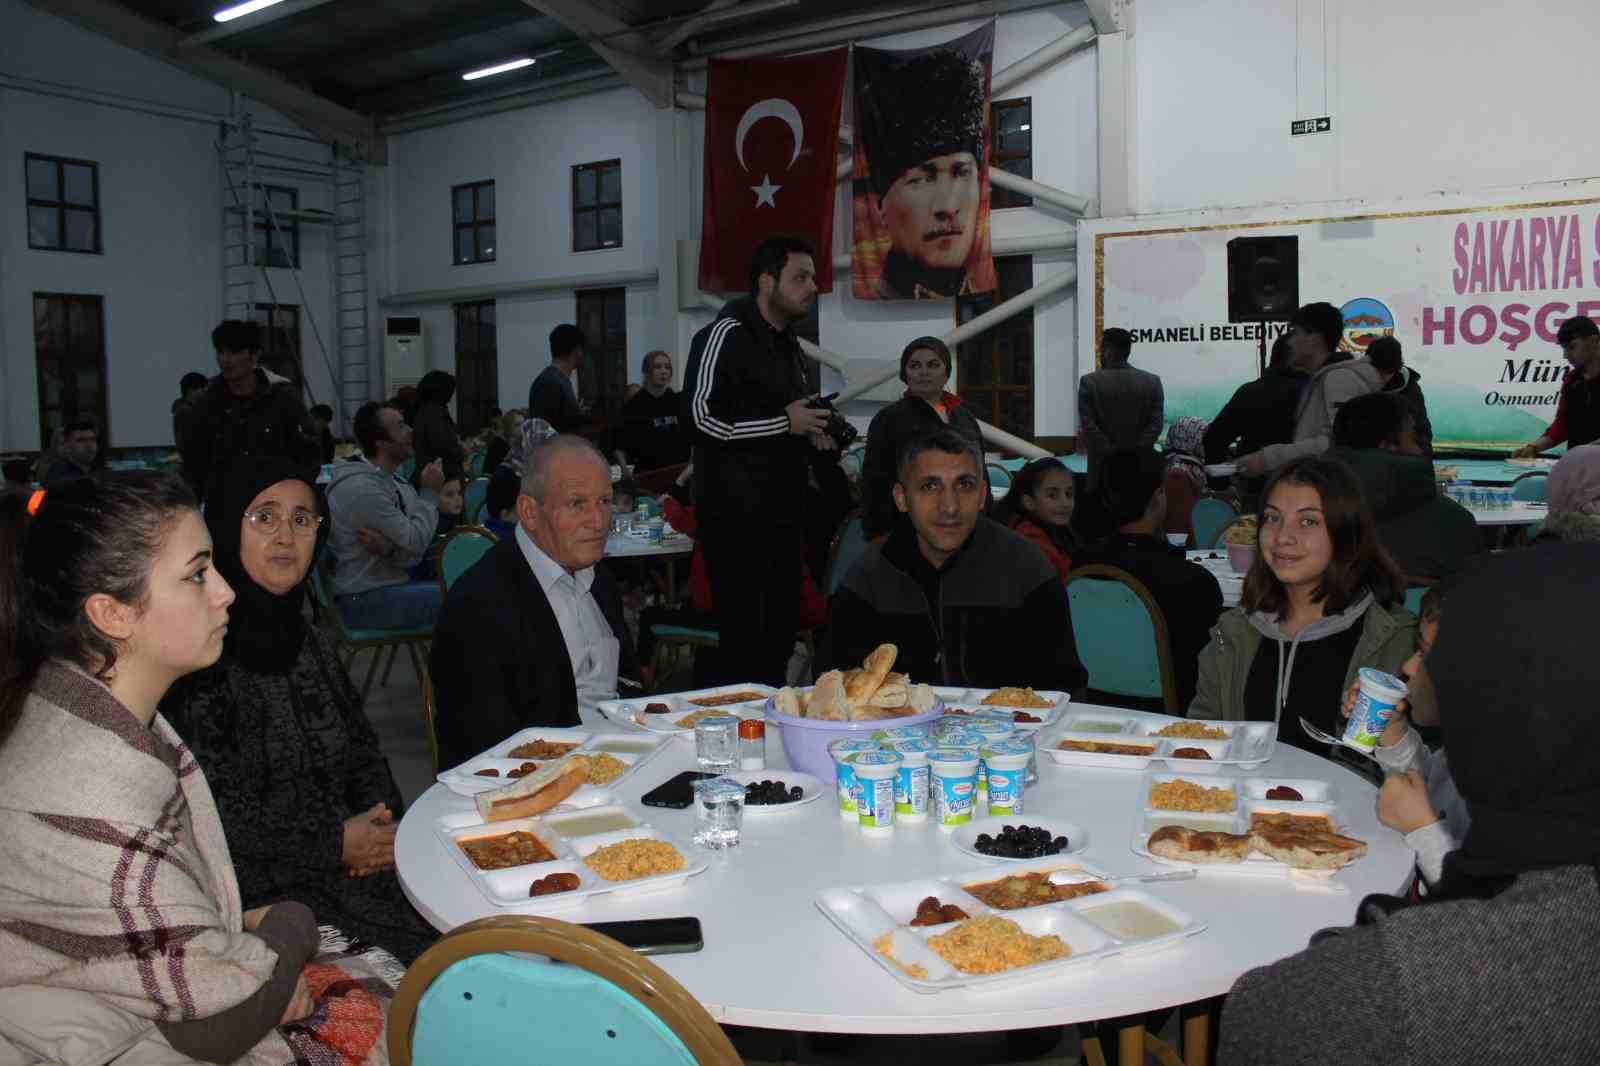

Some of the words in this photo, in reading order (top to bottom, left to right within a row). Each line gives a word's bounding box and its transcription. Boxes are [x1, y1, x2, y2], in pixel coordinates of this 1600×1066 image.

[1452, 214, 1583, 295] SAKARYA
[1127, 323, 1204, 343] SMANELİ
[1210, 320, 1288, 342] BELEDİY
